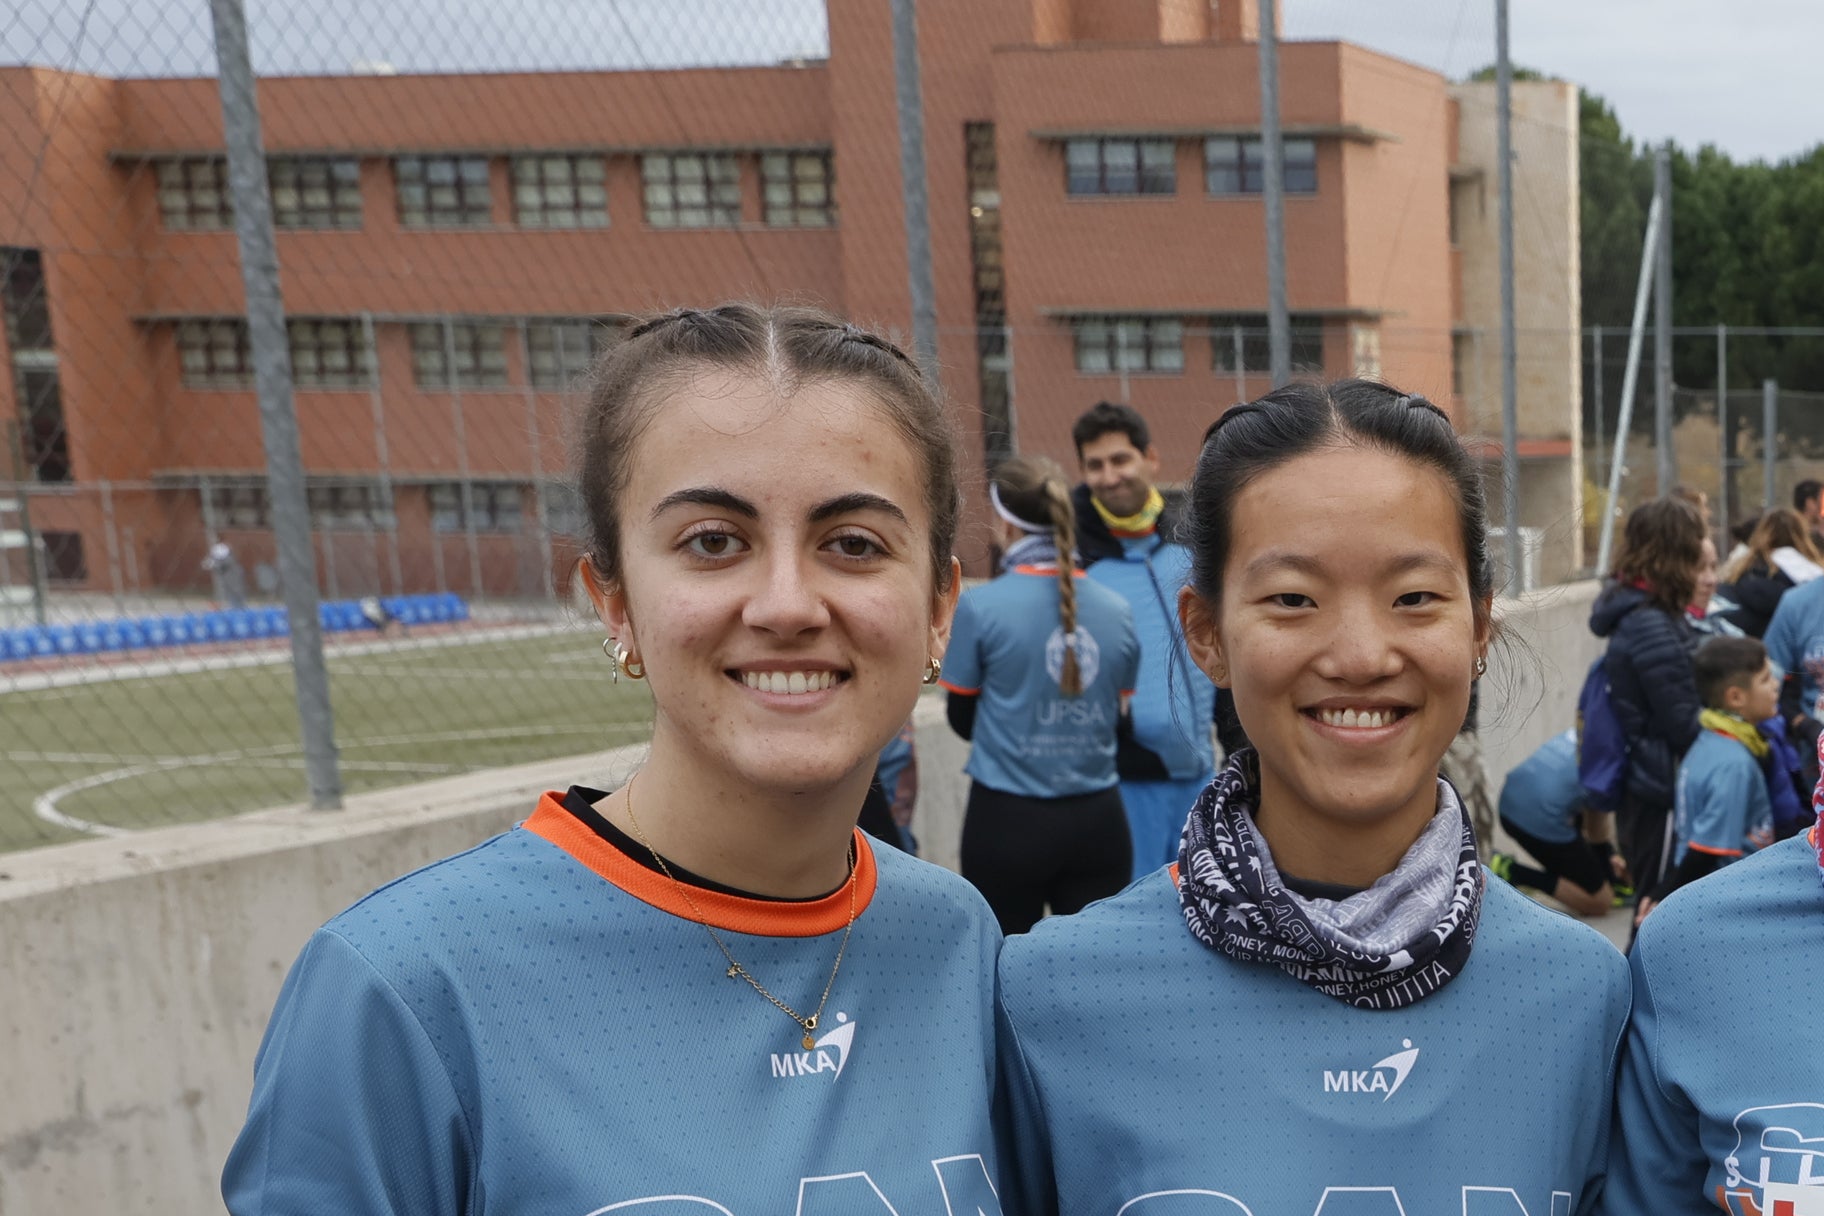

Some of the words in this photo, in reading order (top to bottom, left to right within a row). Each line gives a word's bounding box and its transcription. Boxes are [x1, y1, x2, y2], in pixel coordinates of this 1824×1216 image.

[1036, 702, 1106, 726] UPSA
[770, 1050, 838, 1078] MKA
[1323, 1070, 1389, 1092] MKA
